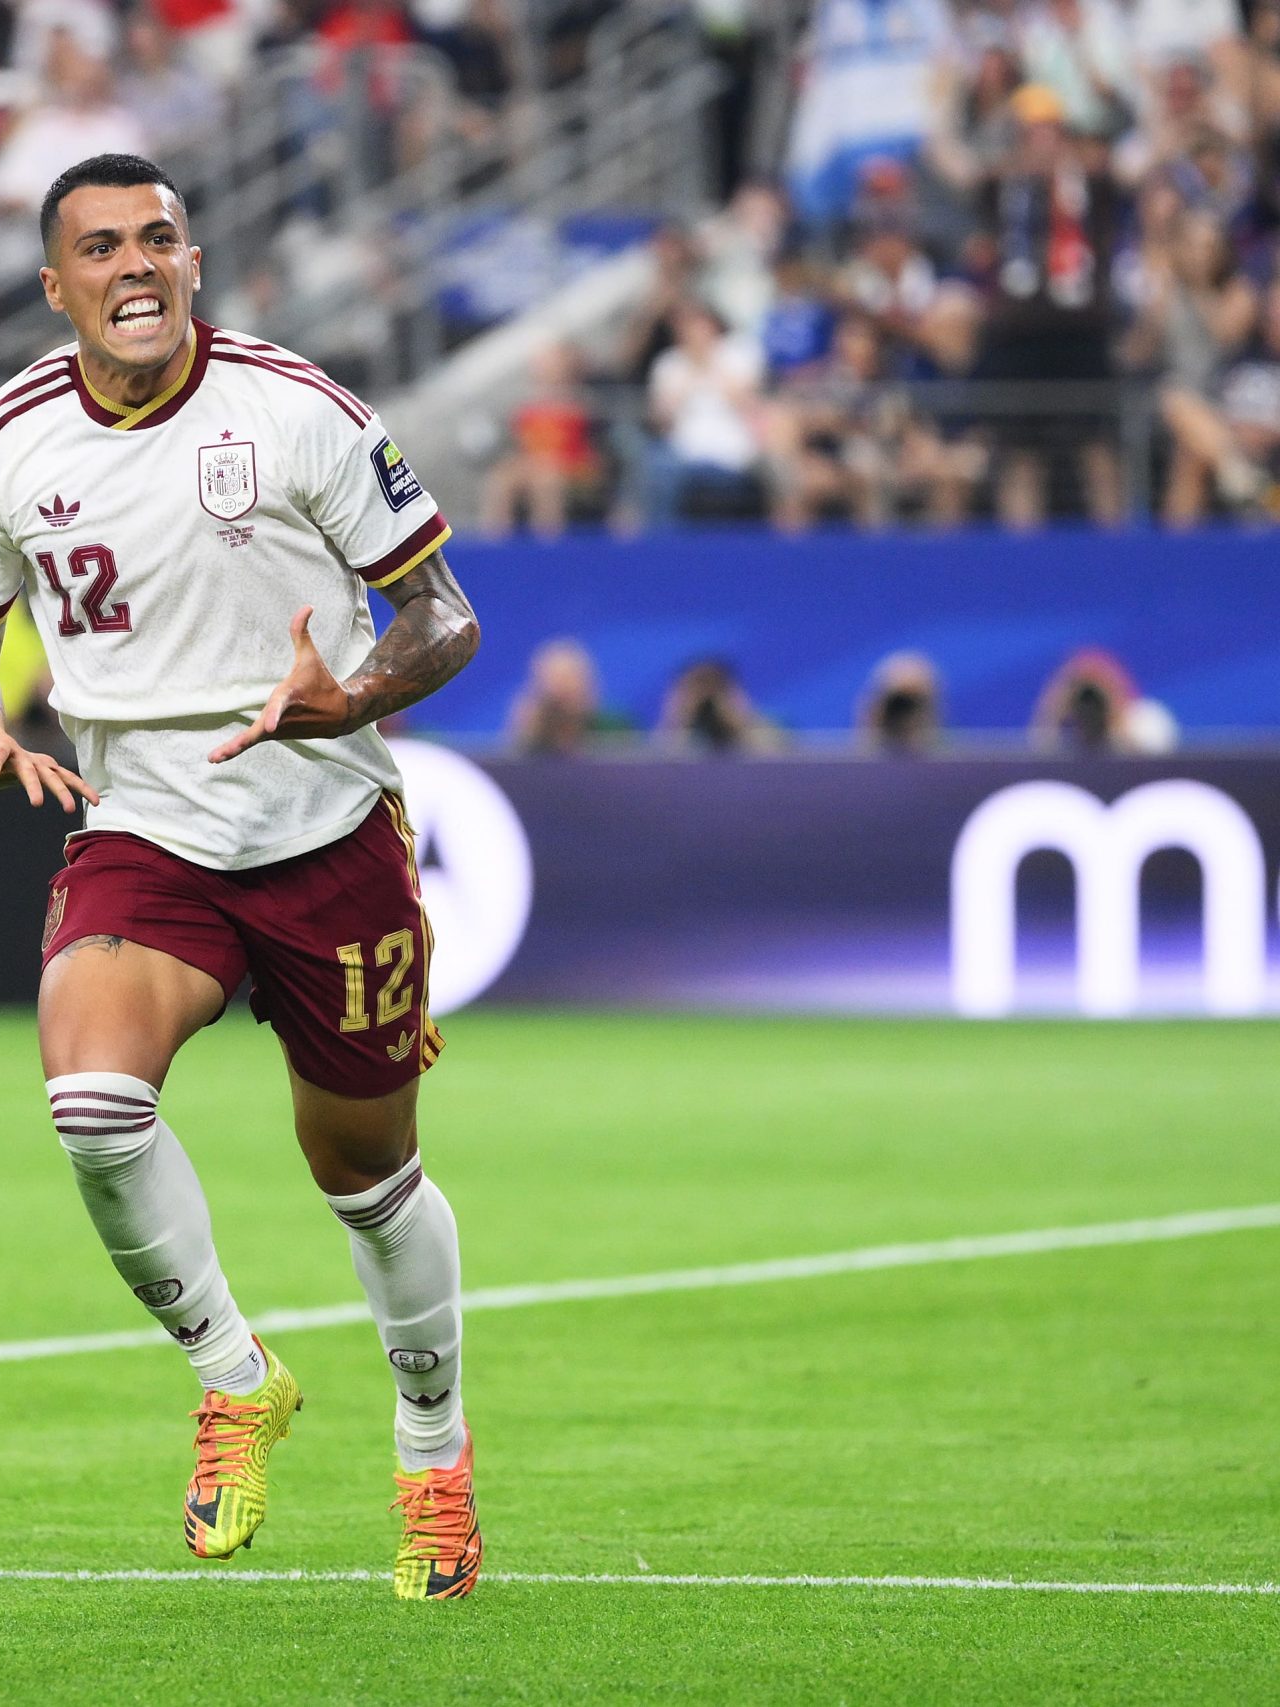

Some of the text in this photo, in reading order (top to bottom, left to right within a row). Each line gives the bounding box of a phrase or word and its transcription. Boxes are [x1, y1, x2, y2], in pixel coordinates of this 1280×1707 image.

[390, 472, 416, 496] EDUCAT
[403, 483, 419, 495] FIFA
[35, 543, 133, 637] 12
[949, 778, 1280, 1018] m
[336, 927, 415, 1032] 12
